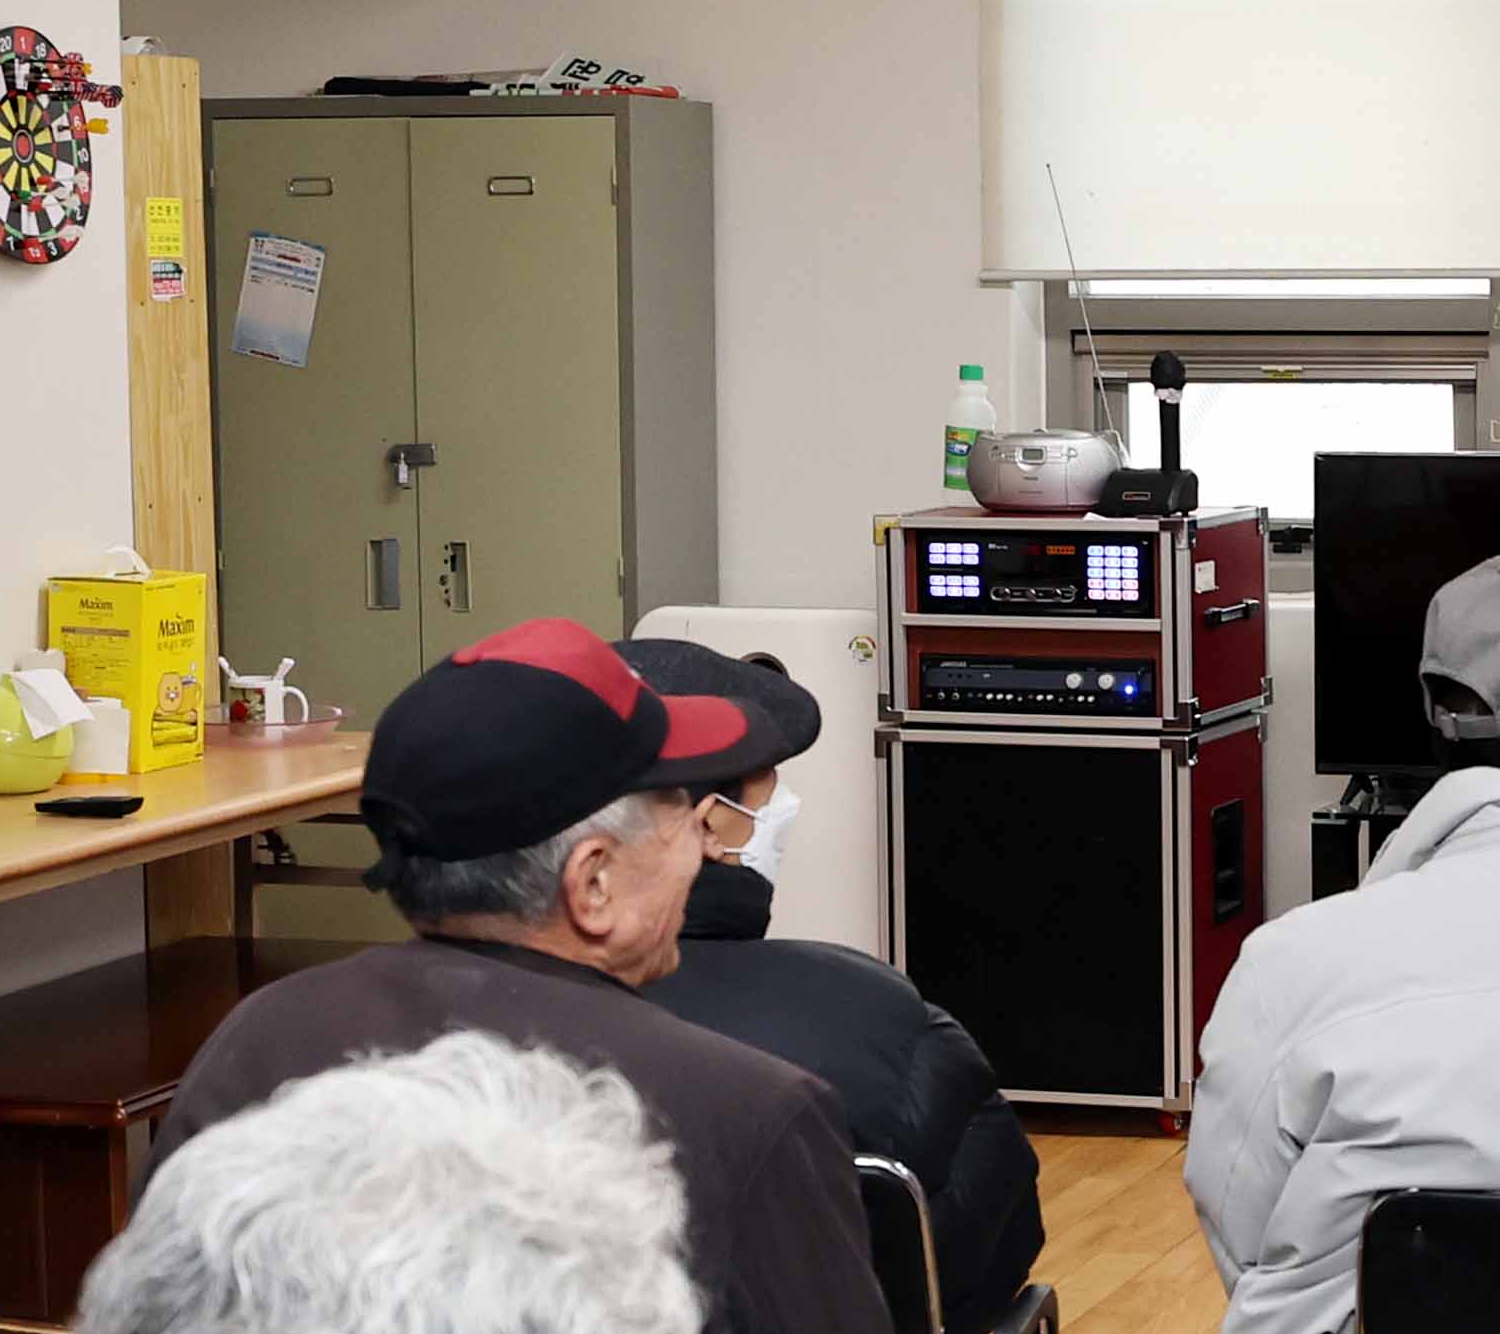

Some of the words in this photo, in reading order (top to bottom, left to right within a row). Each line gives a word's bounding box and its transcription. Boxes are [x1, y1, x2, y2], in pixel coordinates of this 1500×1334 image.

[0, 36, 12, 52] 20
[20, 37, 26, 51] 1
[78, 148, 88, 162] 10
[7, 237, 14, 251] 7
[49, 241, 58, 256] 3
[79, 597, 112, 611] Maxim
[158, 613, 195, 638] Maxim
